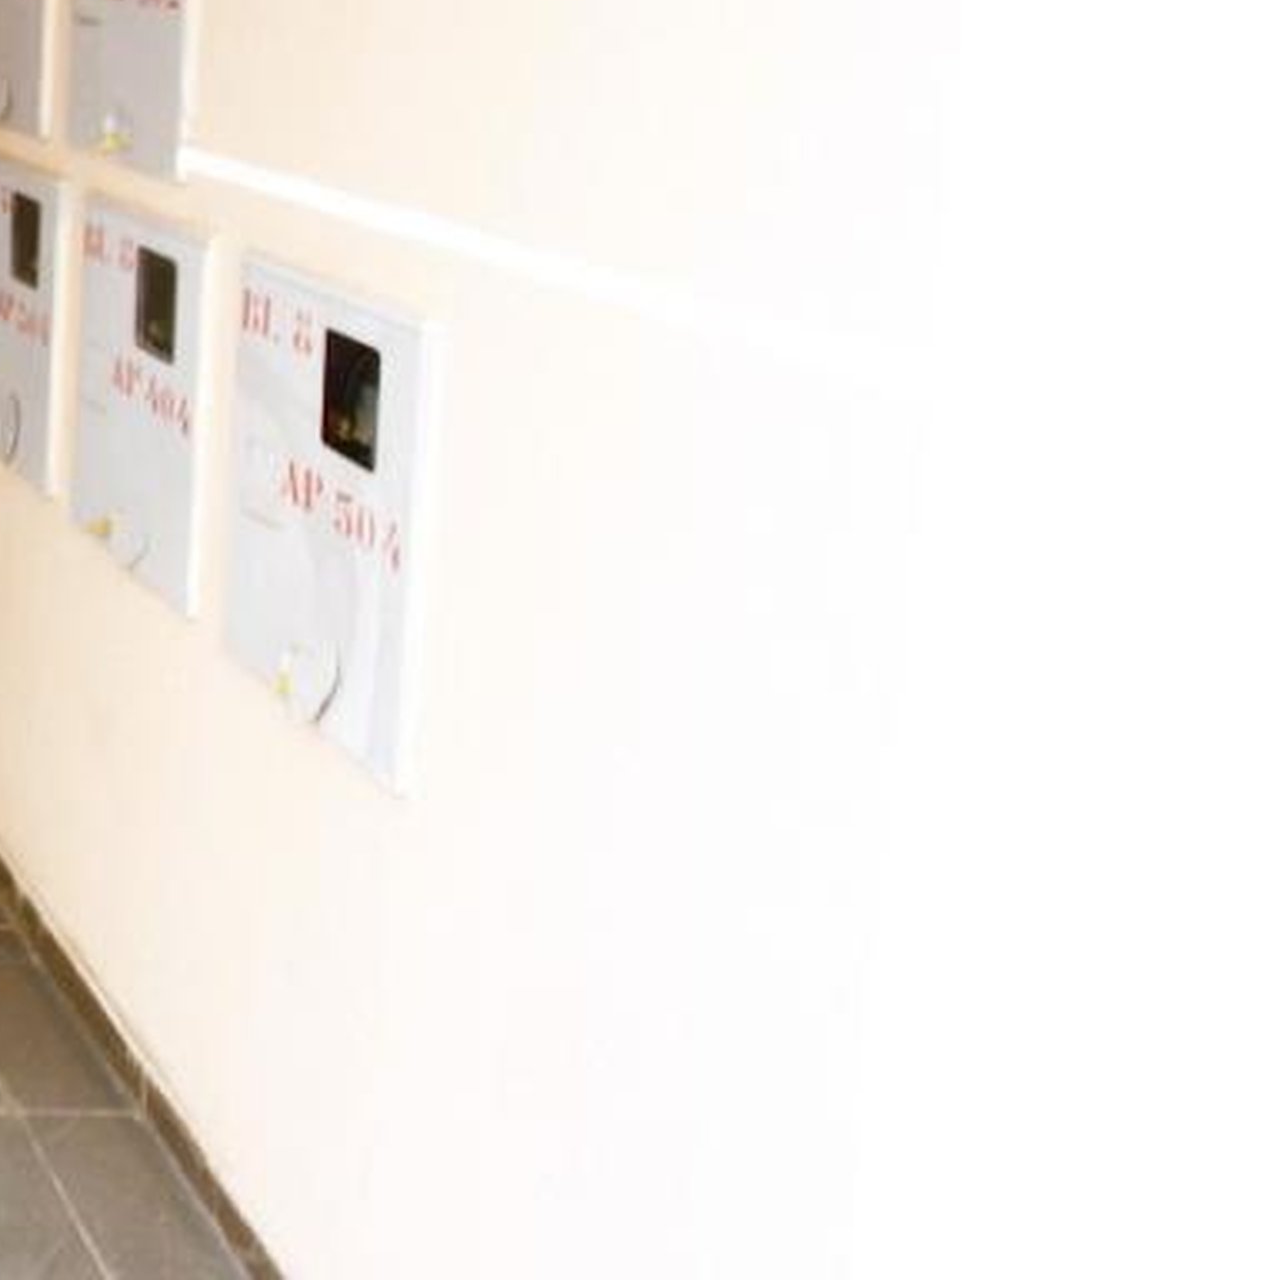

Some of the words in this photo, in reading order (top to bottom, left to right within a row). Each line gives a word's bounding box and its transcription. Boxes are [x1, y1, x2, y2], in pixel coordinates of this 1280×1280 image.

[110, 357, 143, 399] AP
[281, 461, 324, 512] AP
[334, 492, 401, 572] 504
